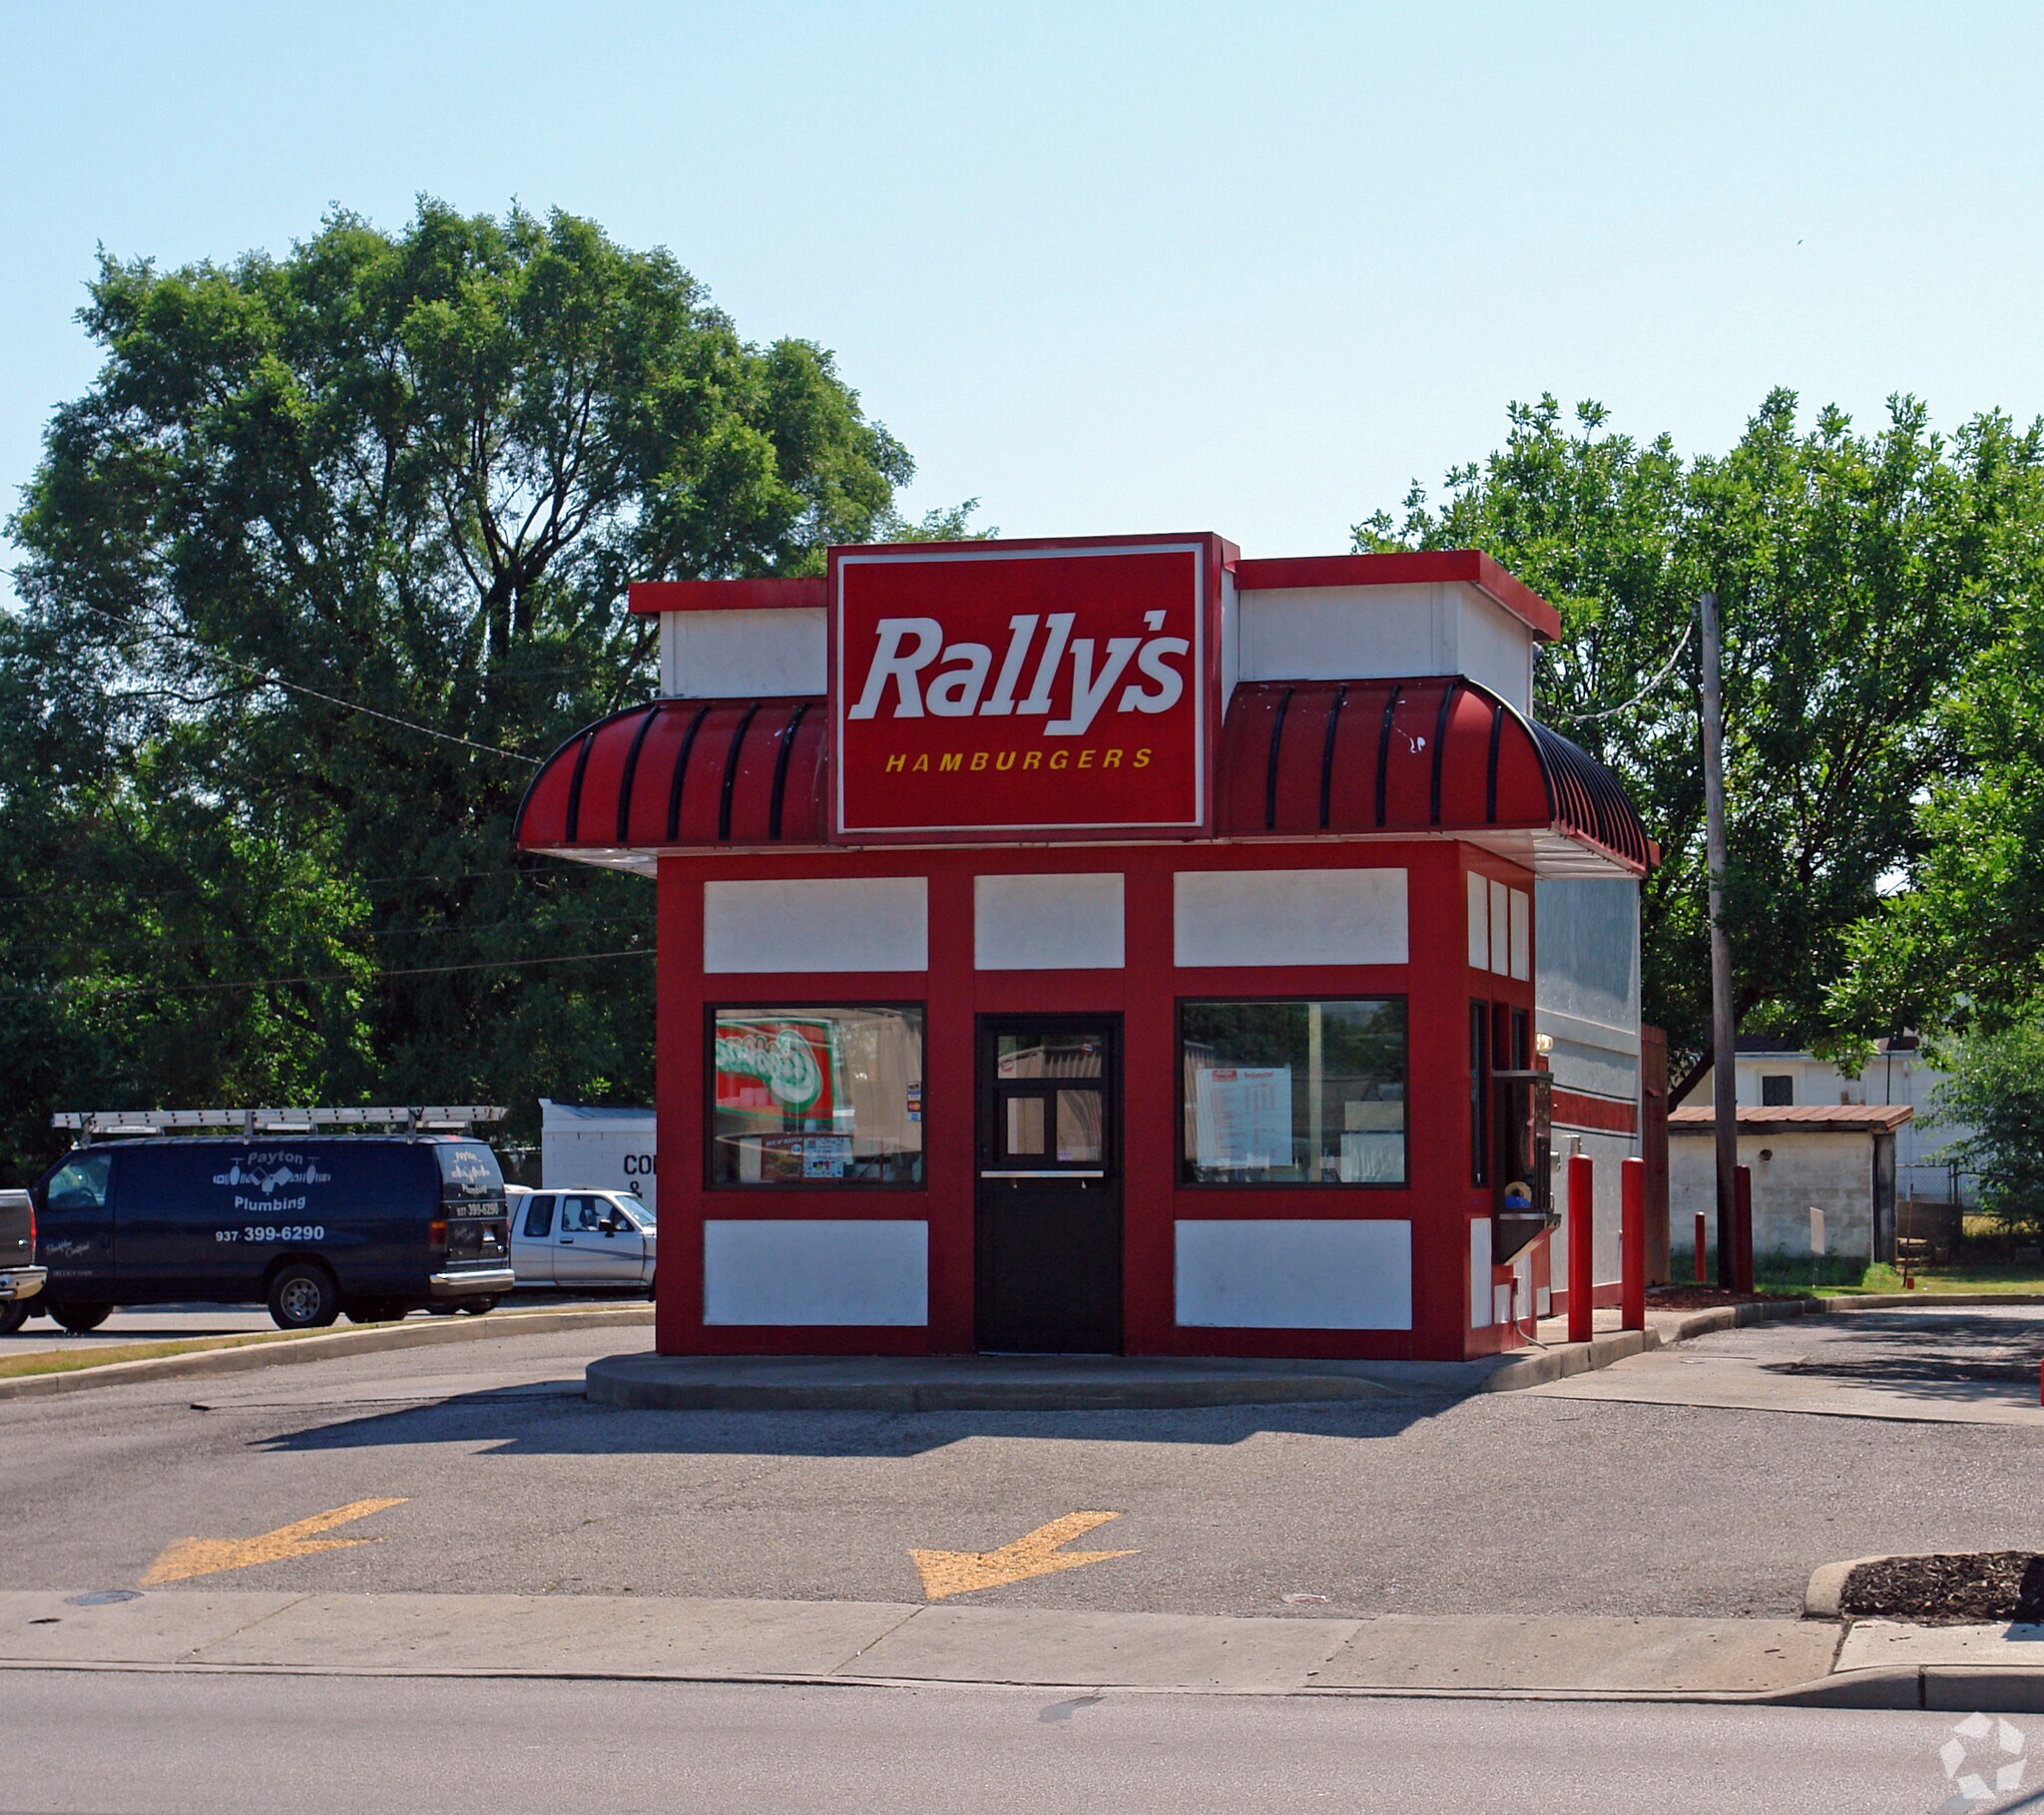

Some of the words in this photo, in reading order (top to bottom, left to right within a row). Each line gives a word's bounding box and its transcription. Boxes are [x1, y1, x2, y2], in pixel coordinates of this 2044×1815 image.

[848, 610, 1190, 736] Rally's
[885, 747, 1153, 773] HAMBURGERS
[248, 1149, 303, 1164] Payton
[624, 1154, 657, 1174] CO
[235, 1195, 306, 1212] Plumbing
[244, 1225, 324, 1241] 399-6290
